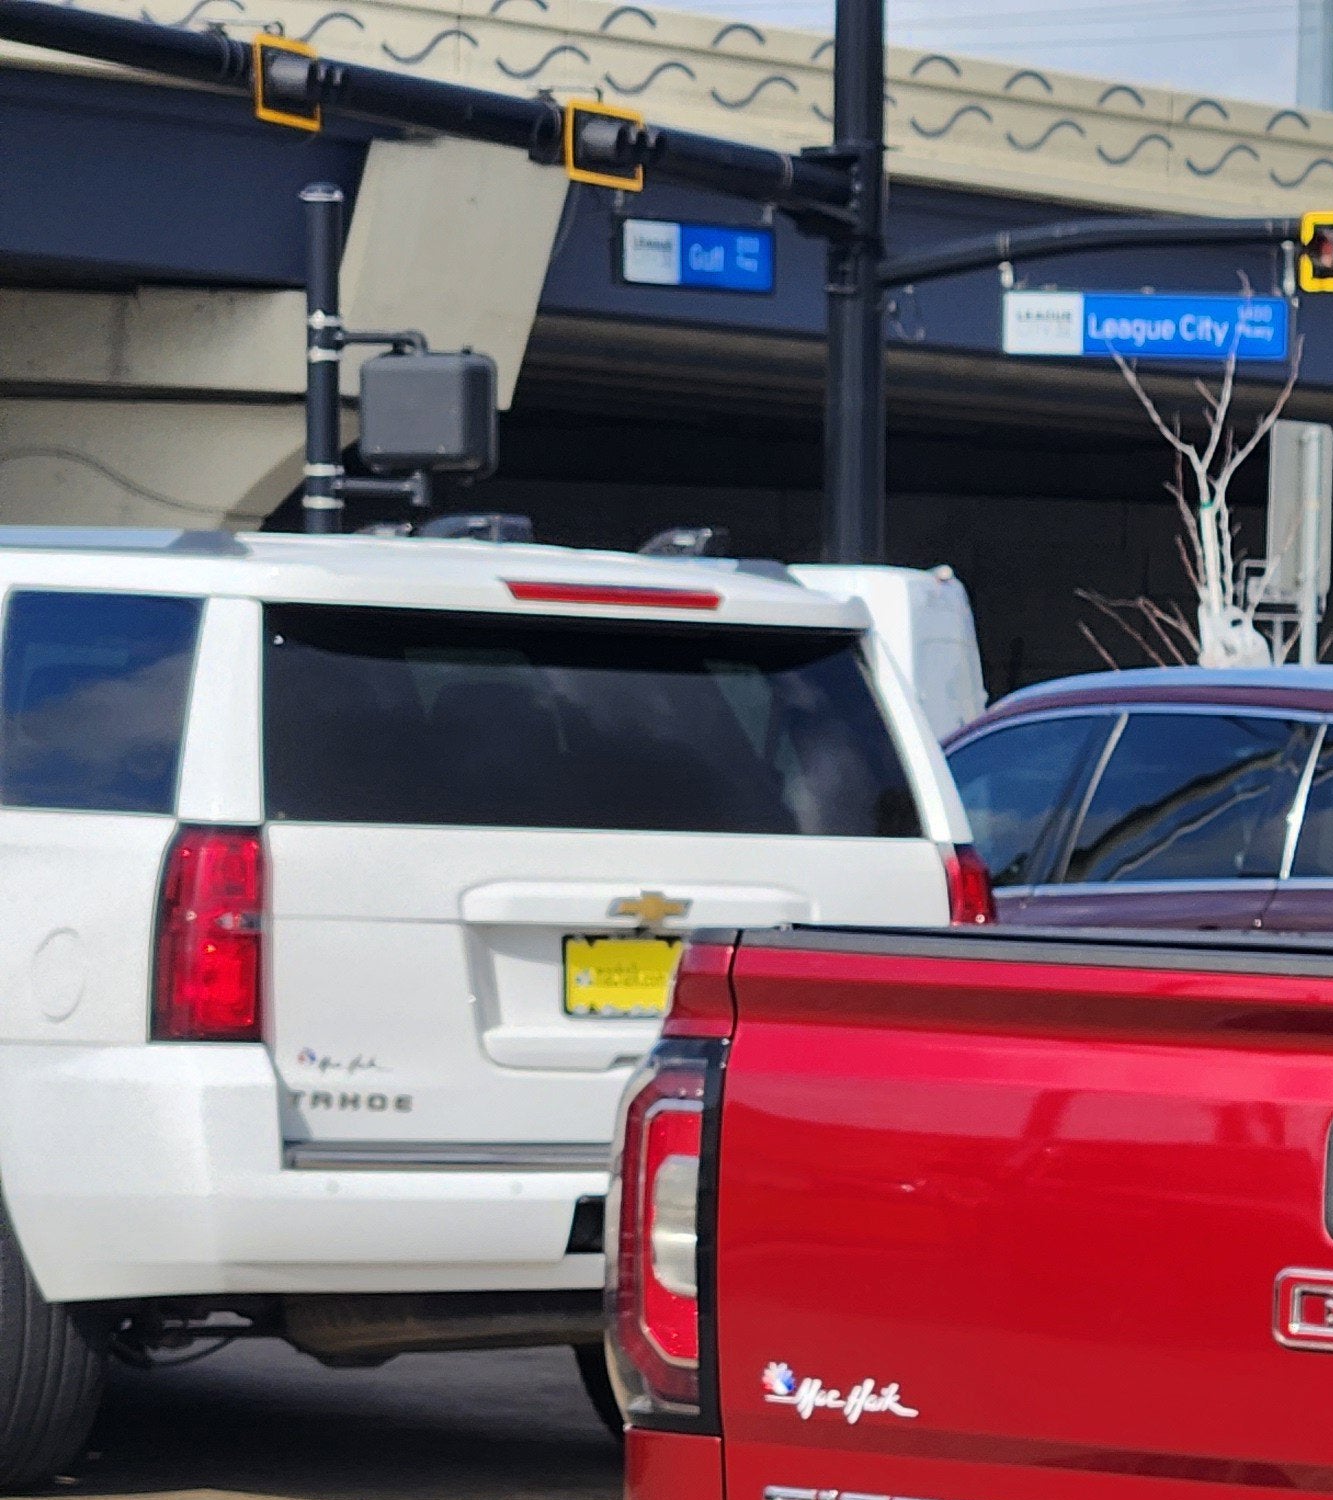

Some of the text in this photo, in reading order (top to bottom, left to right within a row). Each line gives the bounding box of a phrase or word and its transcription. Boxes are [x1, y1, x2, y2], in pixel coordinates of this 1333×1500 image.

[1087, 312, 1176, 348] League
[1179, 313, 1230, 348] City
[288, 1089, 413, 1113] TAHOE
